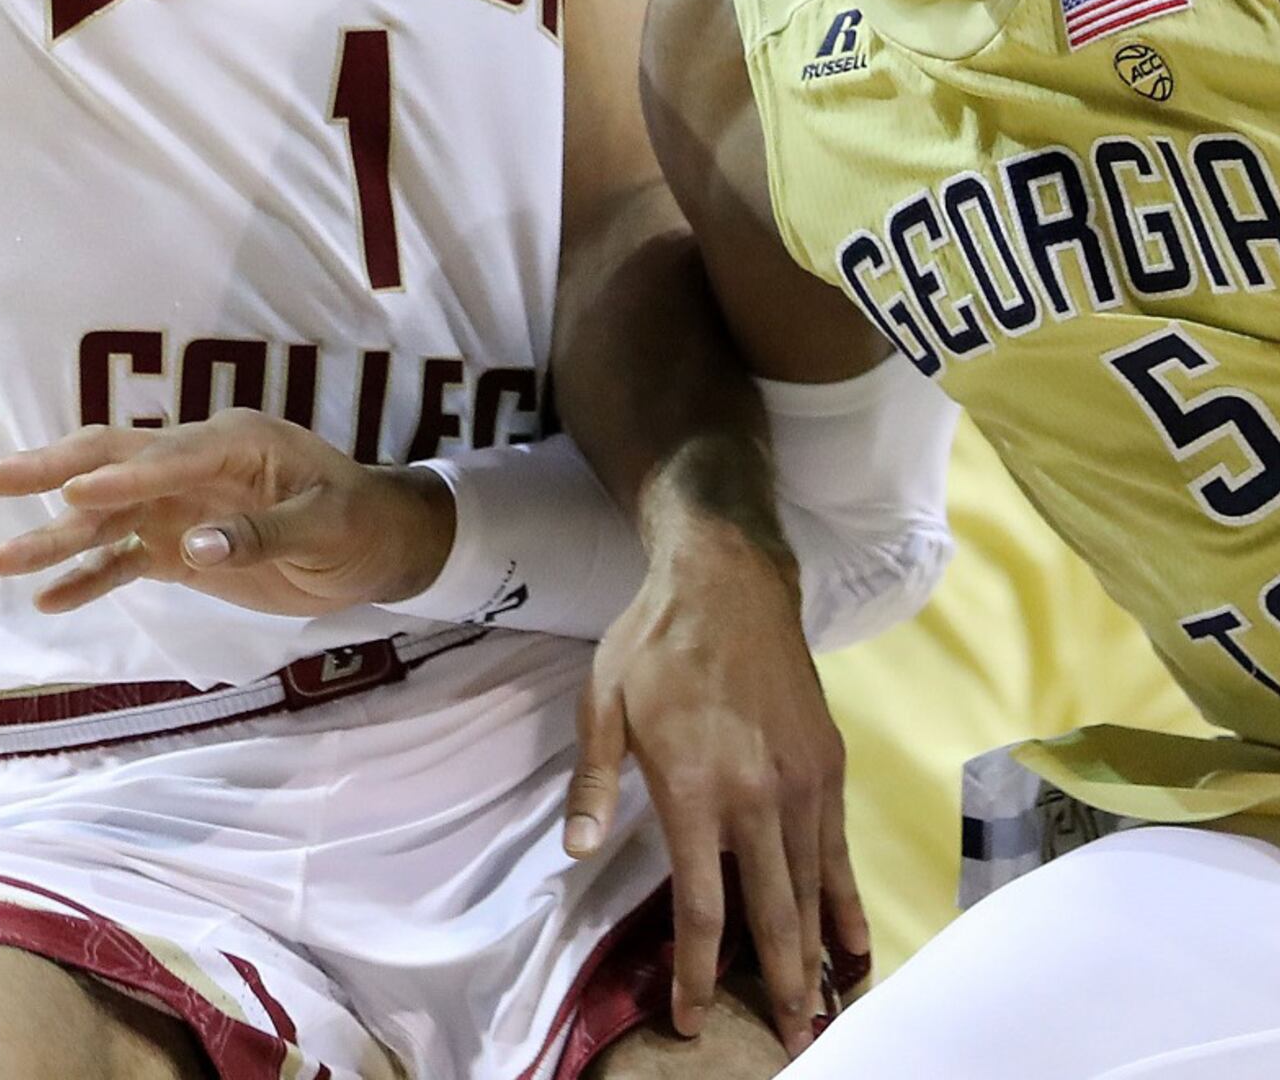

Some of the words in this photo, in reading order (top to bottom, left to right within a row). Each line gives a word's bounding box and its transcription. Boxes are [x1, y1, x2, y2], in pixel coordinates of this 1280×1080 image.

[800, 53, 868, 82] RUSSELL
[1130, 53, 1164, 84] ACC
[325, 25, 406, 293] 1
[77, 328, 542, 465] COLEG
